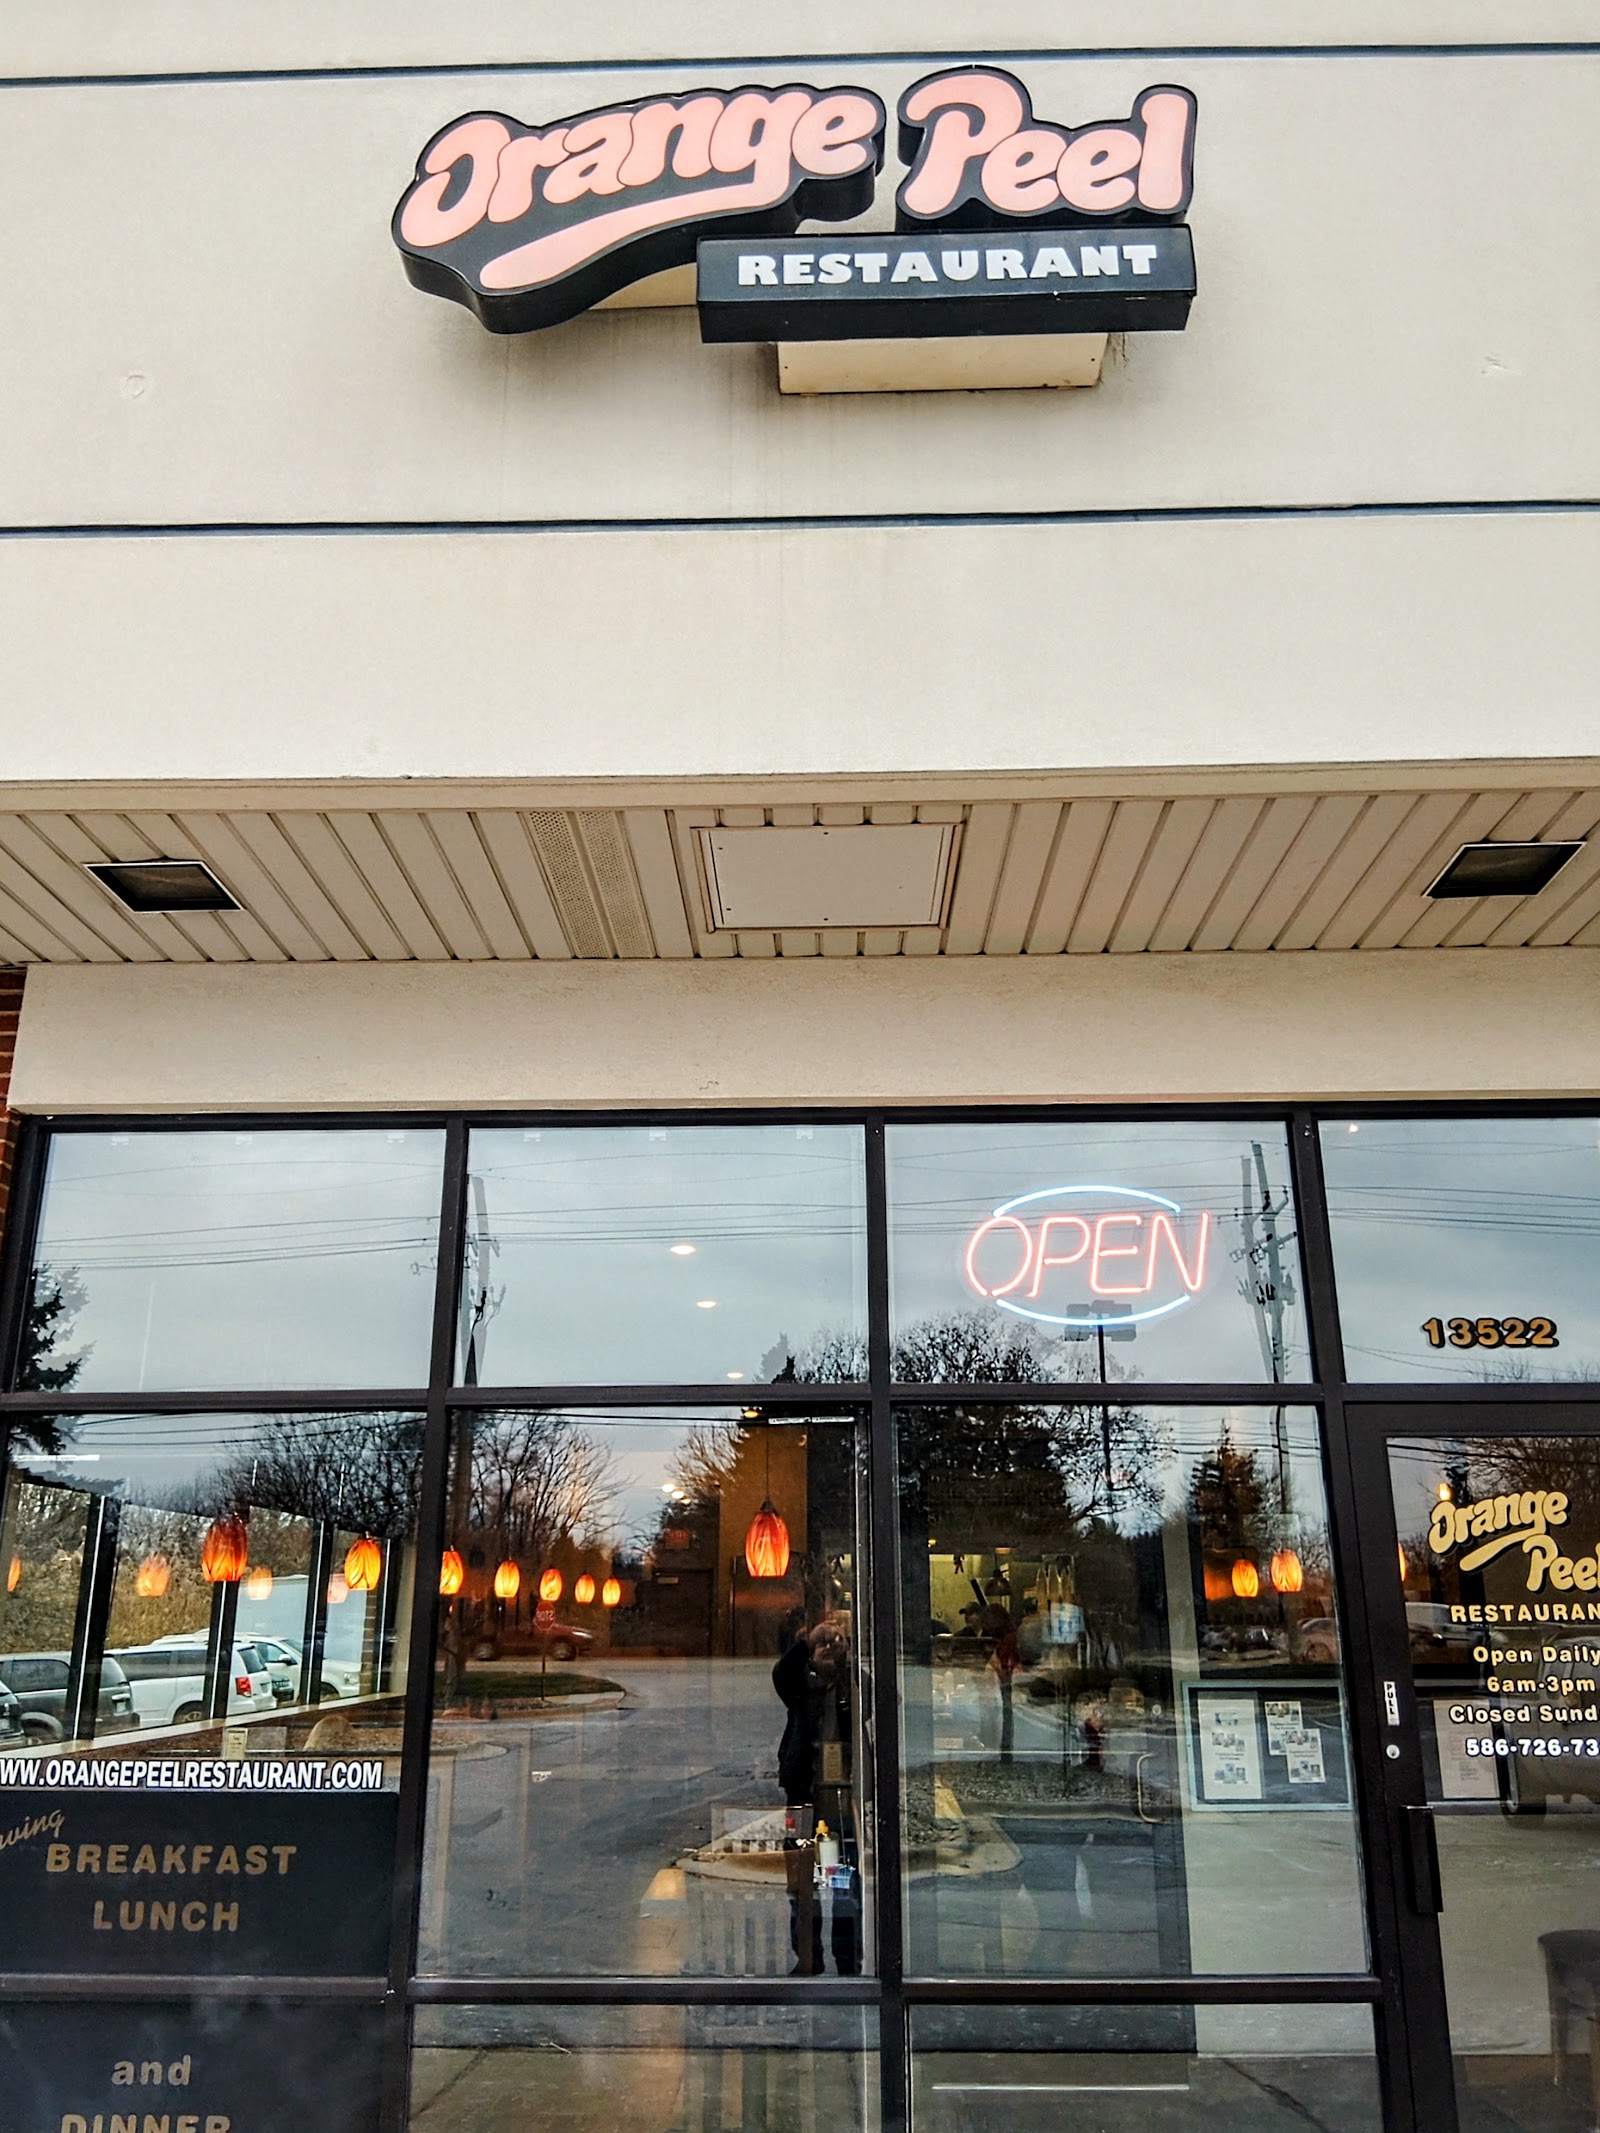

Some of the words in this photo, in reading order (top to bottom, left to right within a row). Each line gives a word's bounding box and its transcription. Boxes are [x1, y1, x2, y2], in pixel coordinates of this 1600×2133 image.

[402, 91, 877, 289] Orange
[896, 74, 1191, 214] Peel
[738, 245, 1157, 286] RESTAURANT
[966, 1210, 1210, 1297] OPEN
[1422, 1317, 1559, 1348] 13522
[1429, 1490, 1568, 1571] Orange
[1473, 1646, 1533, 1666] Open
[1542, 1645, 1600, 1666] Daily
[1386, 1684, 1394, 1715] PULL
[1450, 1705, 1530, 1722] Closed
[1540, 1705, 1598, 1722] Sund
[46, 1843, 298, 1875] BREAKFAST
[94, 1900, 240, 1932] LUNCH
[111, 2054, 192, 2086] and
[61, 2113, 231, 2133] DINNER
